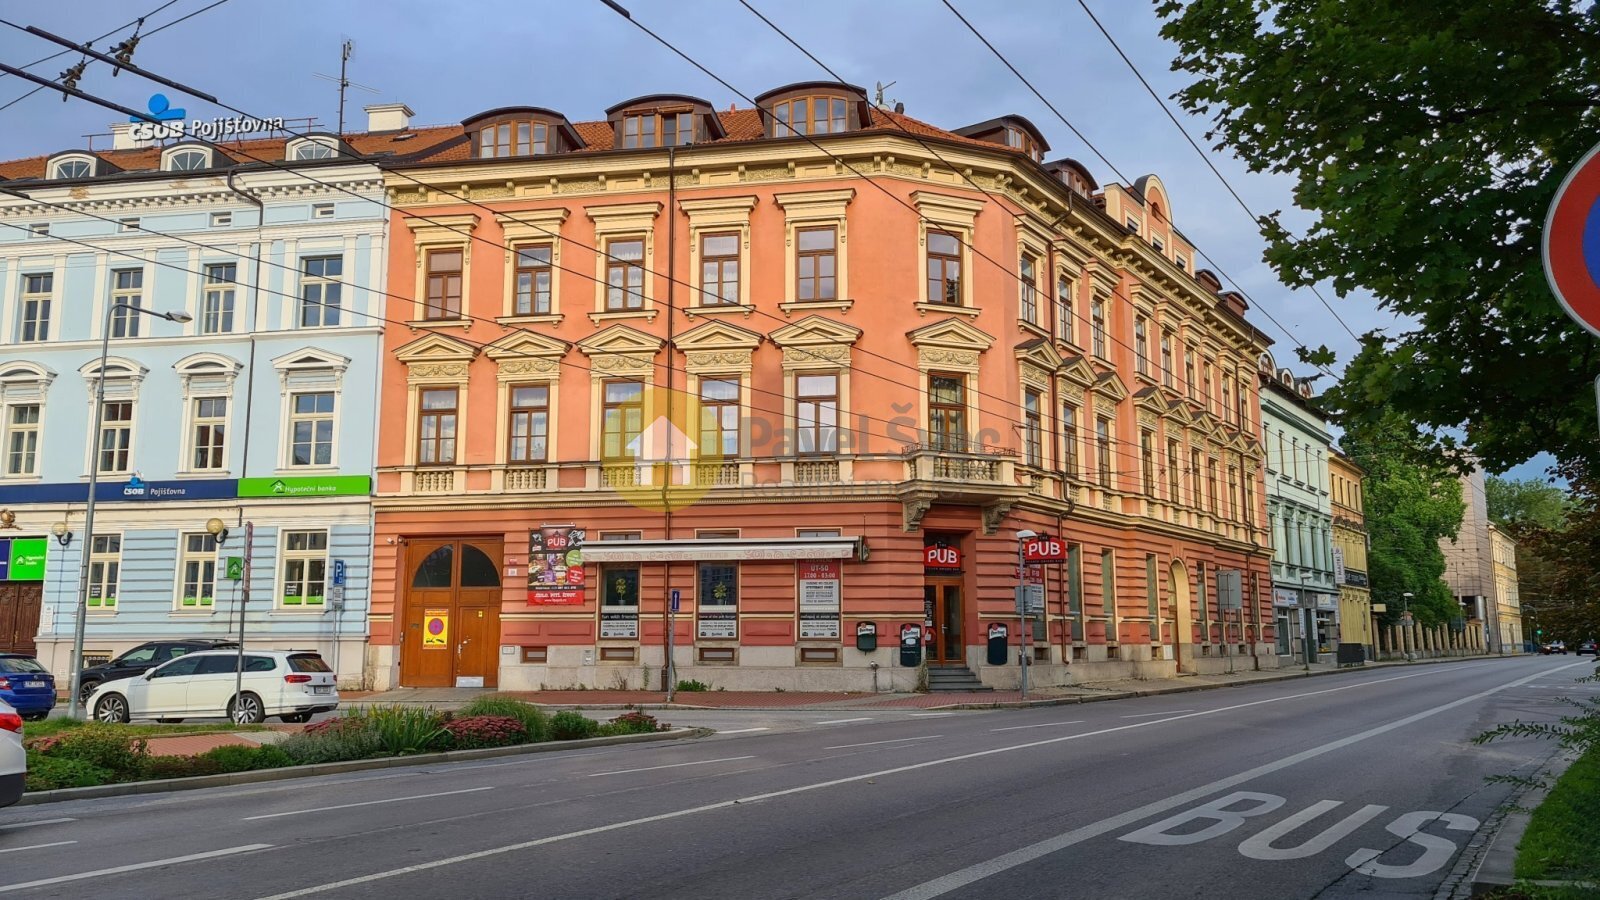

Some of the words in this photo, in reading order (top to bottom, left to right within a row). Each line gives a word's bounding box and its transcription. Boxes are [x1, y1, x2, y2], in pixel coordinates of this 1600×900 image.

[192, 115, 283, 139] Pojišťovna
[150, 487, 186, 497] Pojišťovna
[547, 537, 566, 547] PUB
[1028, 541, 1061, 556] PUB
[928, 548, 958, 564] PUB
[1117, 791, 1481, 879] BUS
